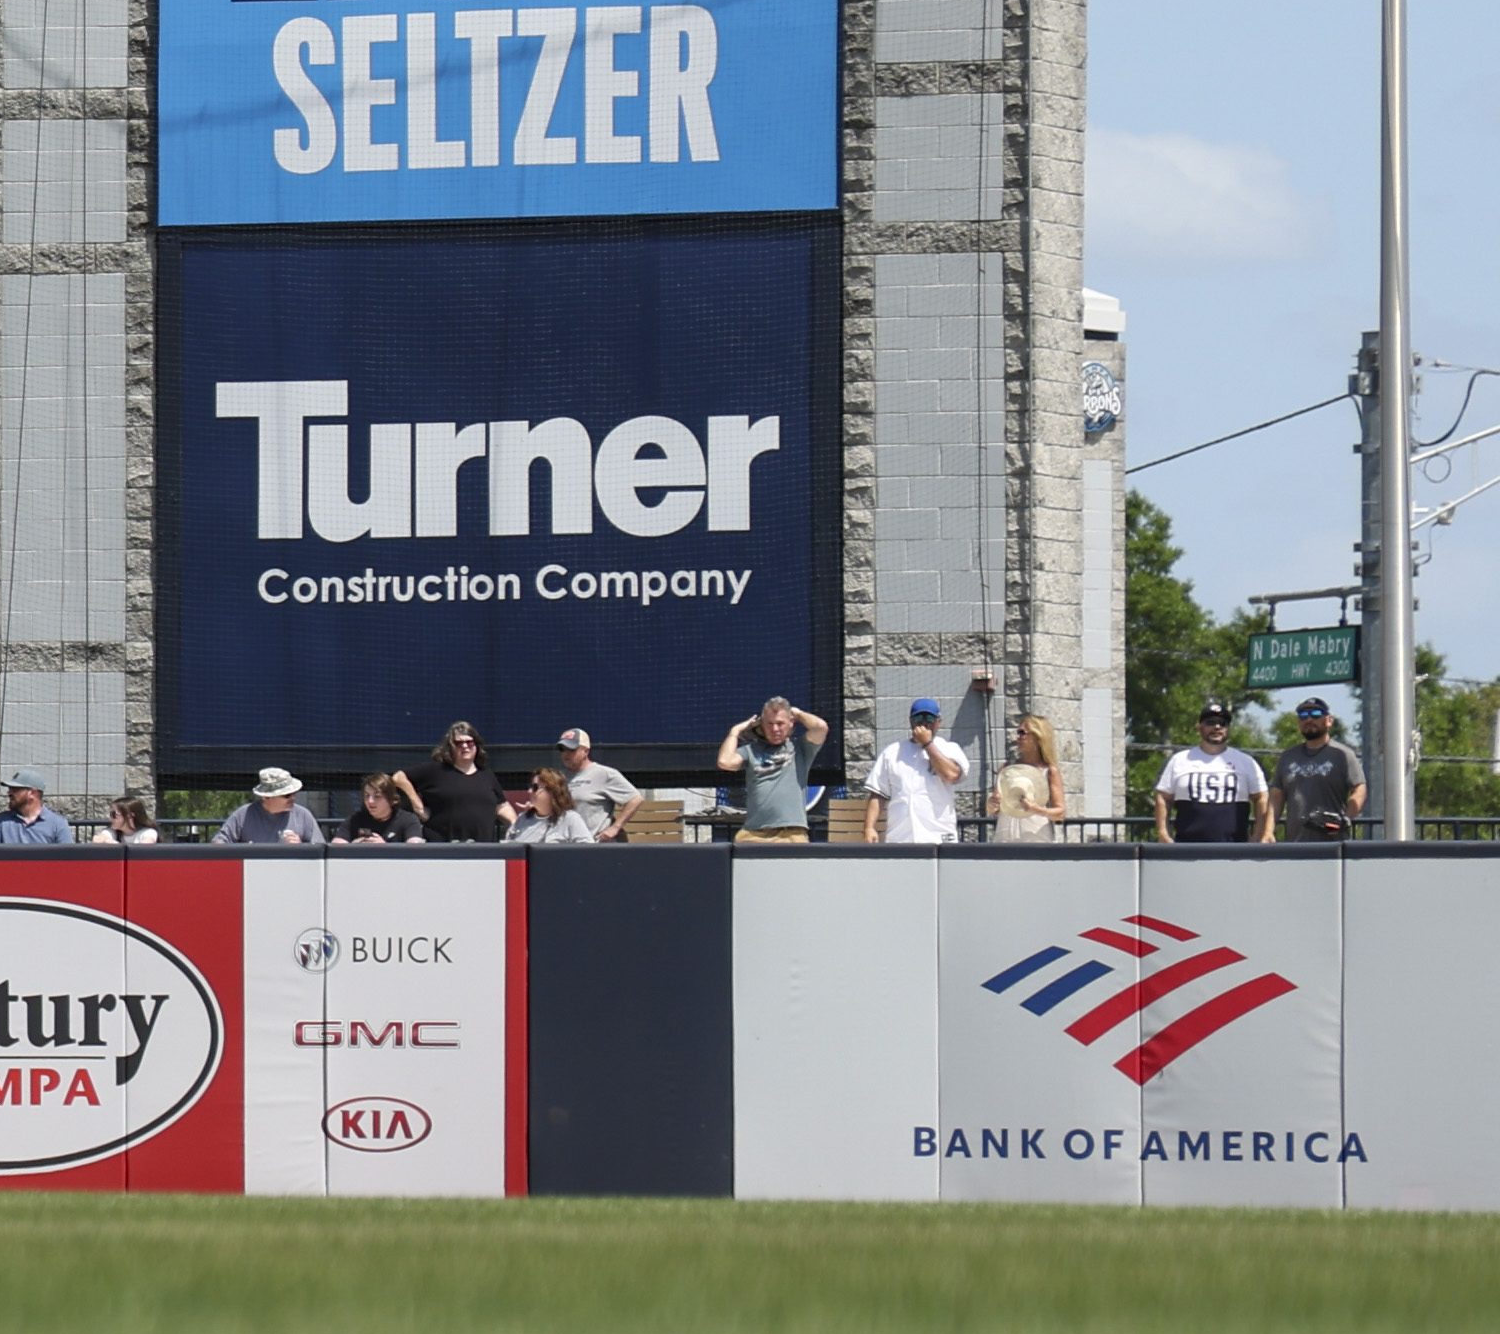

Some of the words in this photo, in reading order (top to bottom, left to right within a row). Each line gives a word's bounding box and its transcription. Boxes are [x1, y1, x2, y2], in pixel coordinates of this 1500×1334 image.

[273, 4, 720, 175] SELTZER
[1083, 387, 1121, 415] RPONS
[216, 380, 780, 542] Turner
[258, 566, 520, 603] Construction
[535, 564, 752, 605] Company
[1253, 641, 1263, 660] N
[1270, 638, 1300, 659] Dale
[1308, 635, 1350, 658] Mabry
[1252, 666, 1277, 681] 4400
[1291, 663, 1312, 679] HWY
[1325, 660, 1350, 676] 4300
[1188, 772, 1238, 803] USA
[352, 936, 453, 964] BUICK
[293, 1020, 461, 1049] GMC
[340, 1110, 414, 1139] KIA
[913, 1126, 1046, 1159] BANK
[1063, 1128, 1124, 1160] OF
[1139, 1130, 1369, 1164] AMERICA
